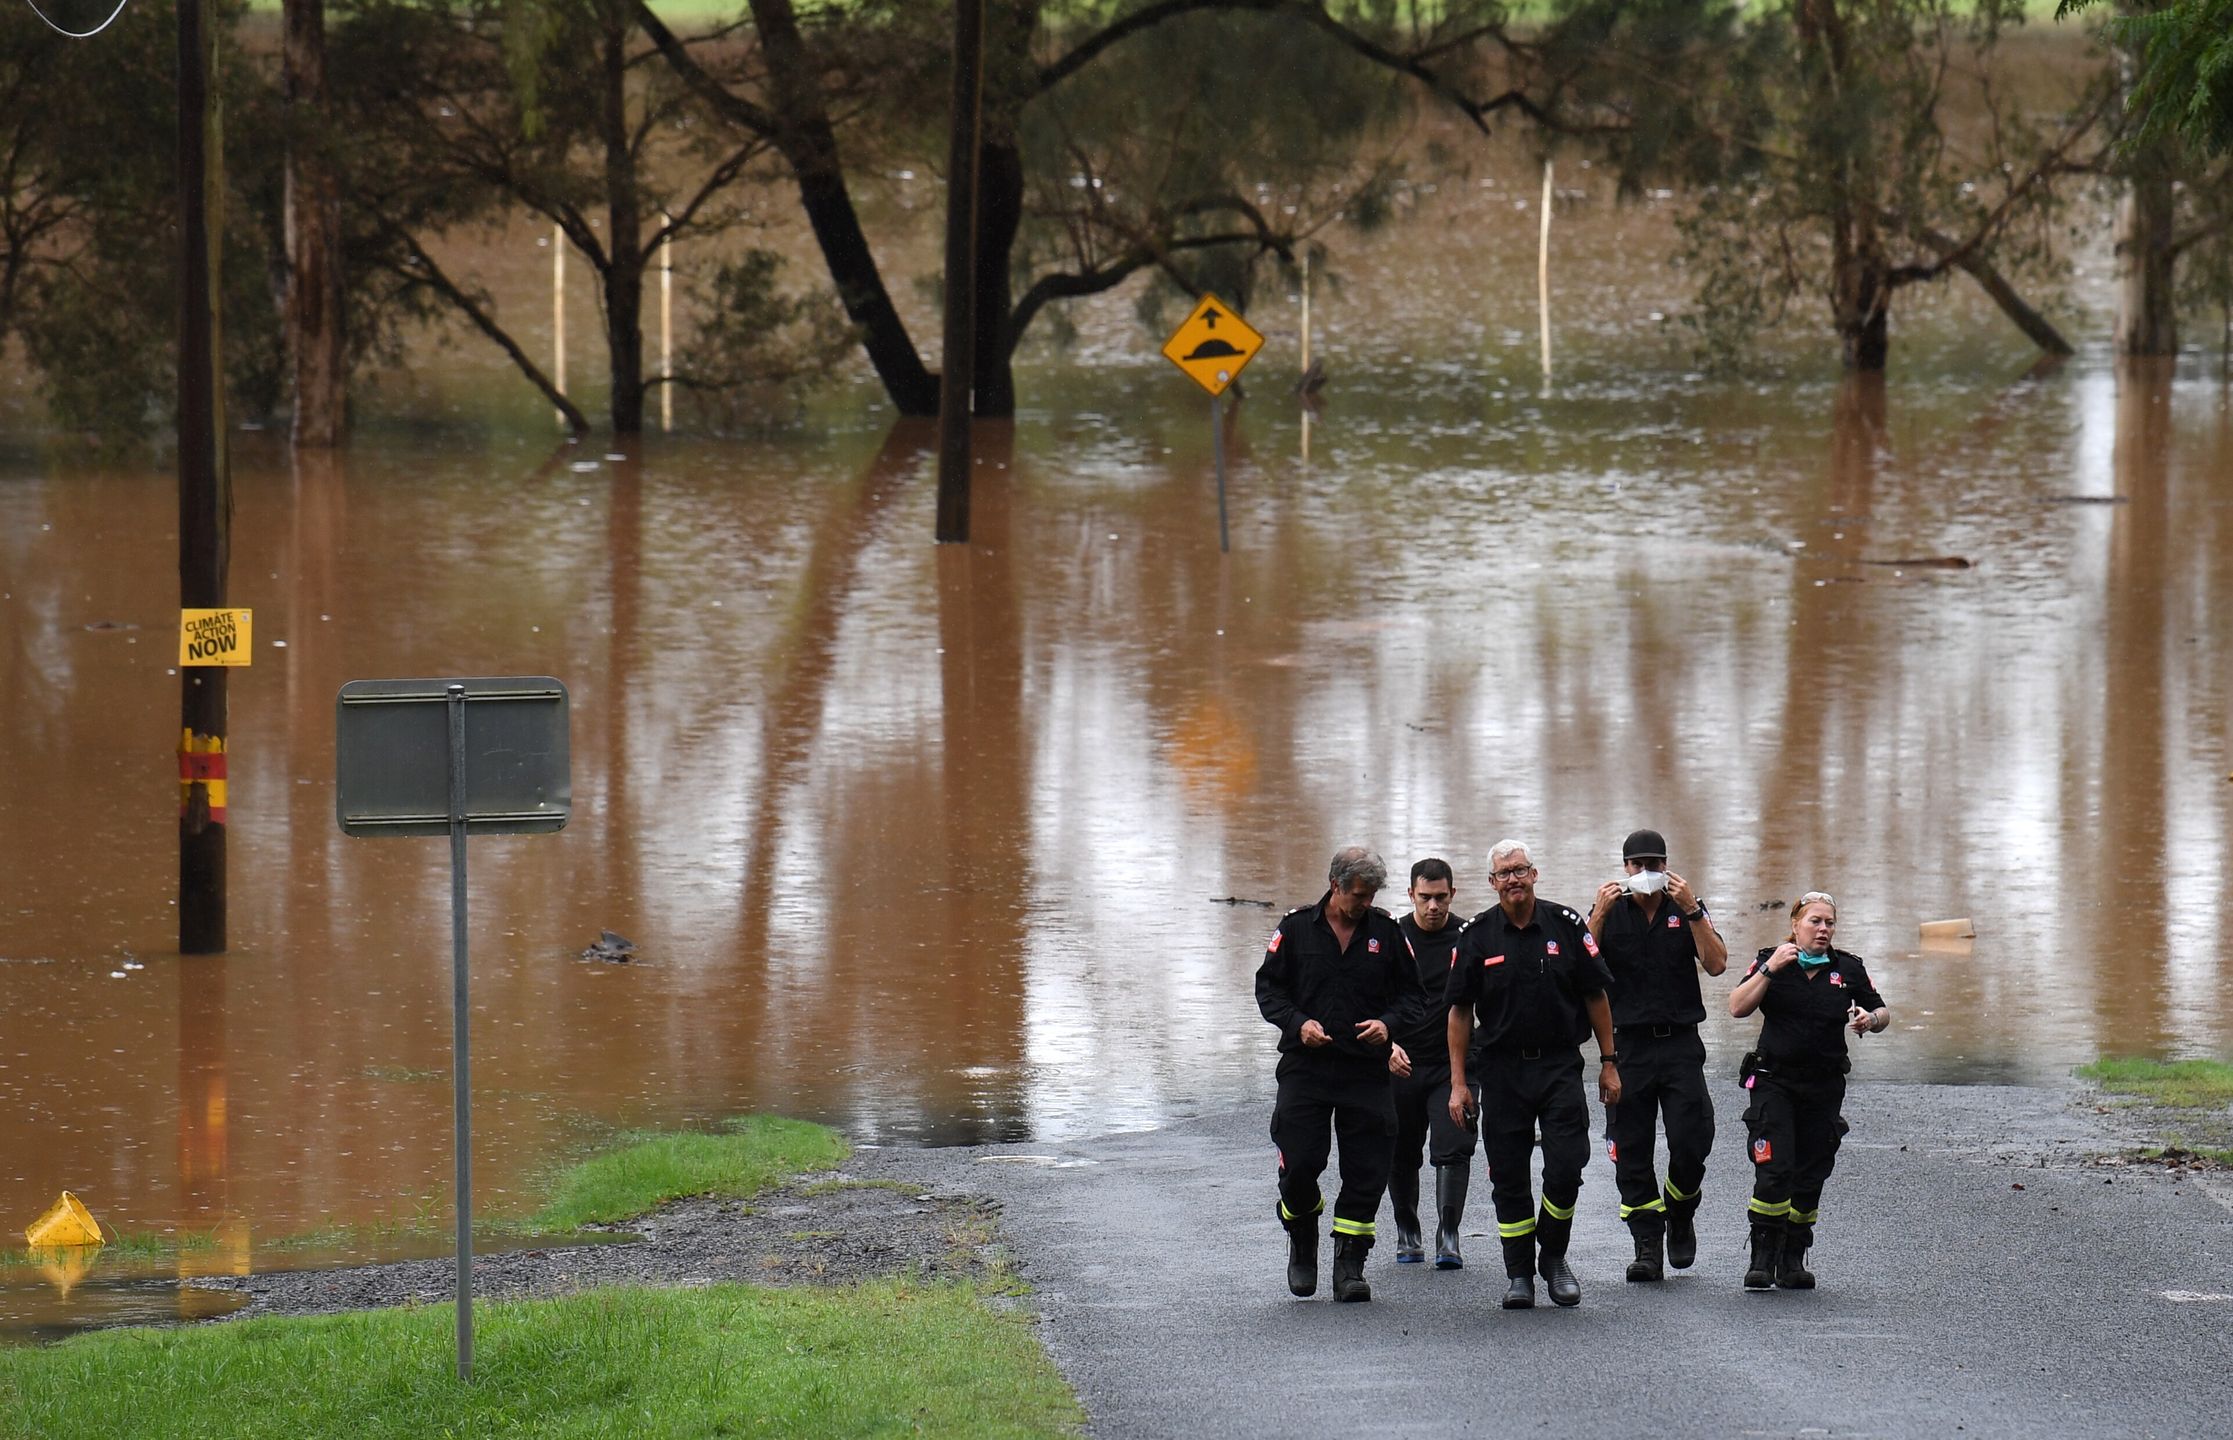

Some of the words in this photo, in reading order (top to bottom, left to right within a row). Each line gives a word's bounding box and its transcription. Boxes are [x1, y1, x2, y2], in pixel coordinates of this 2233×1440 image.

[185, 612, 234, 632] CLIMATE
[194, 623, 236, 641] ACTION
[188, 633, 237, 660] NOW
